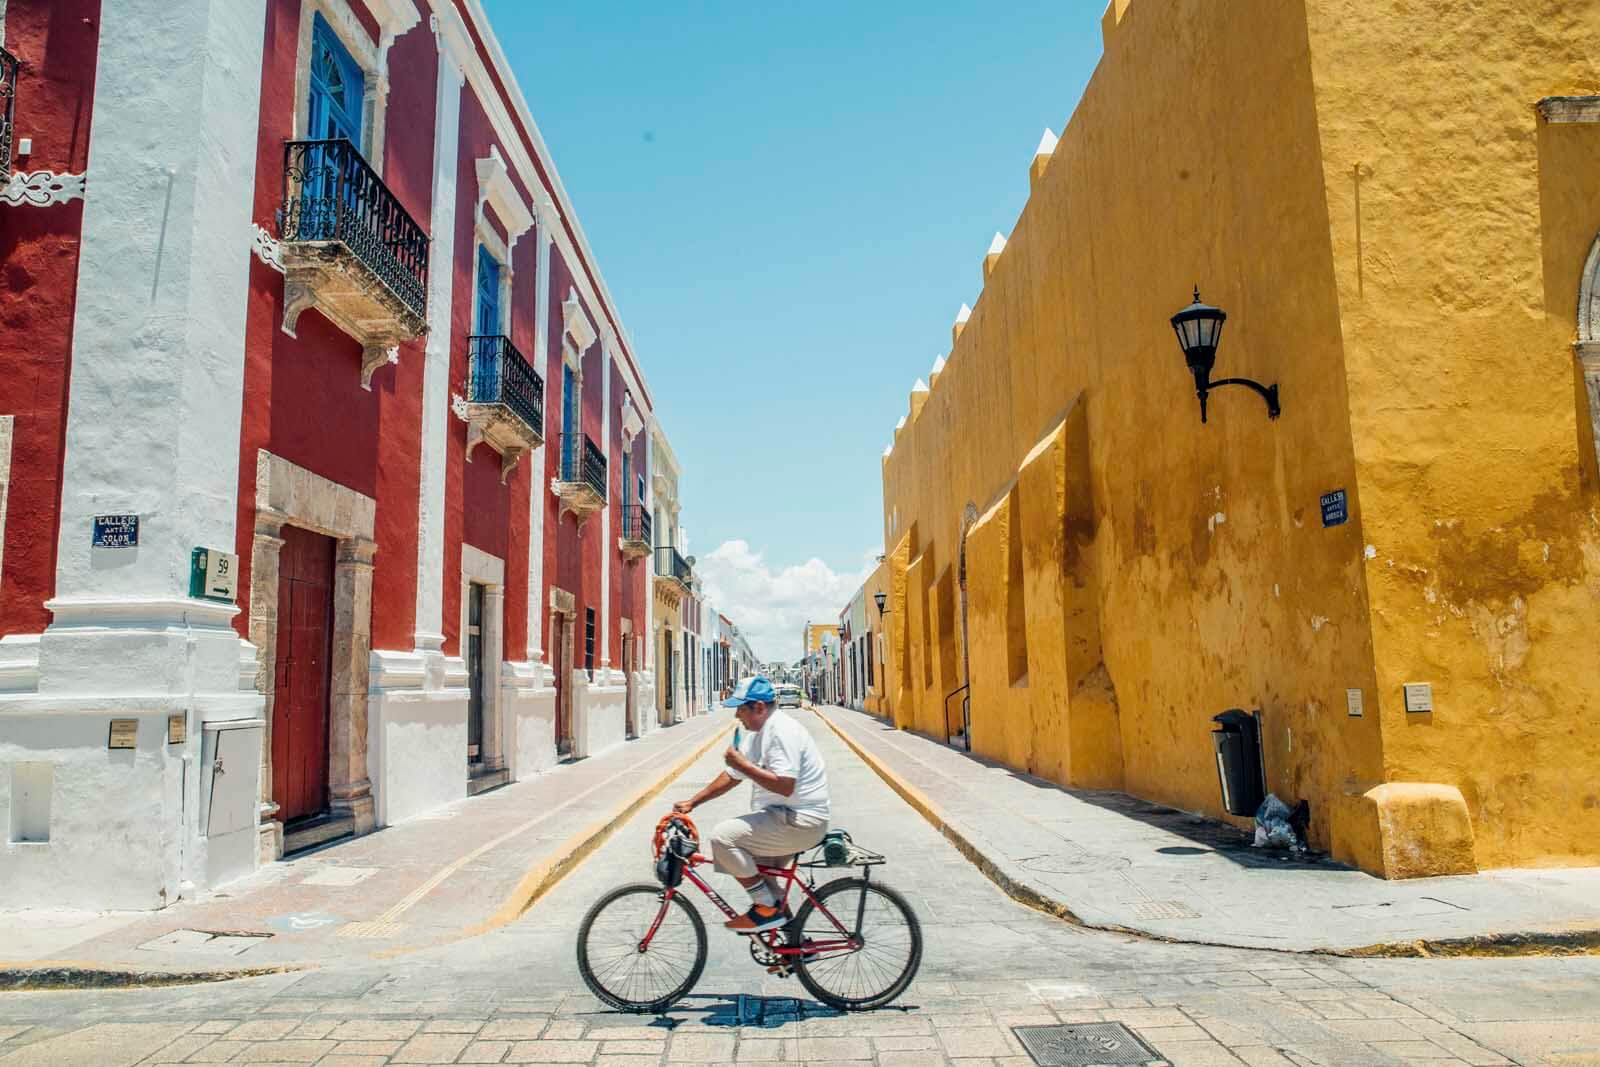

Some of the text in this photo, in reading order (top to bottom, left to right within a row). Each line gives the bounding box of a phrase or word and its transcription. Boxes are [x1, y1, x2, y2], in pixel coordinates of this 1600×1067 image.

[98, 516, 127, 525] CALLE
[102, 535, 129, 543] COLON
[218, 558, 229, 574] 59
